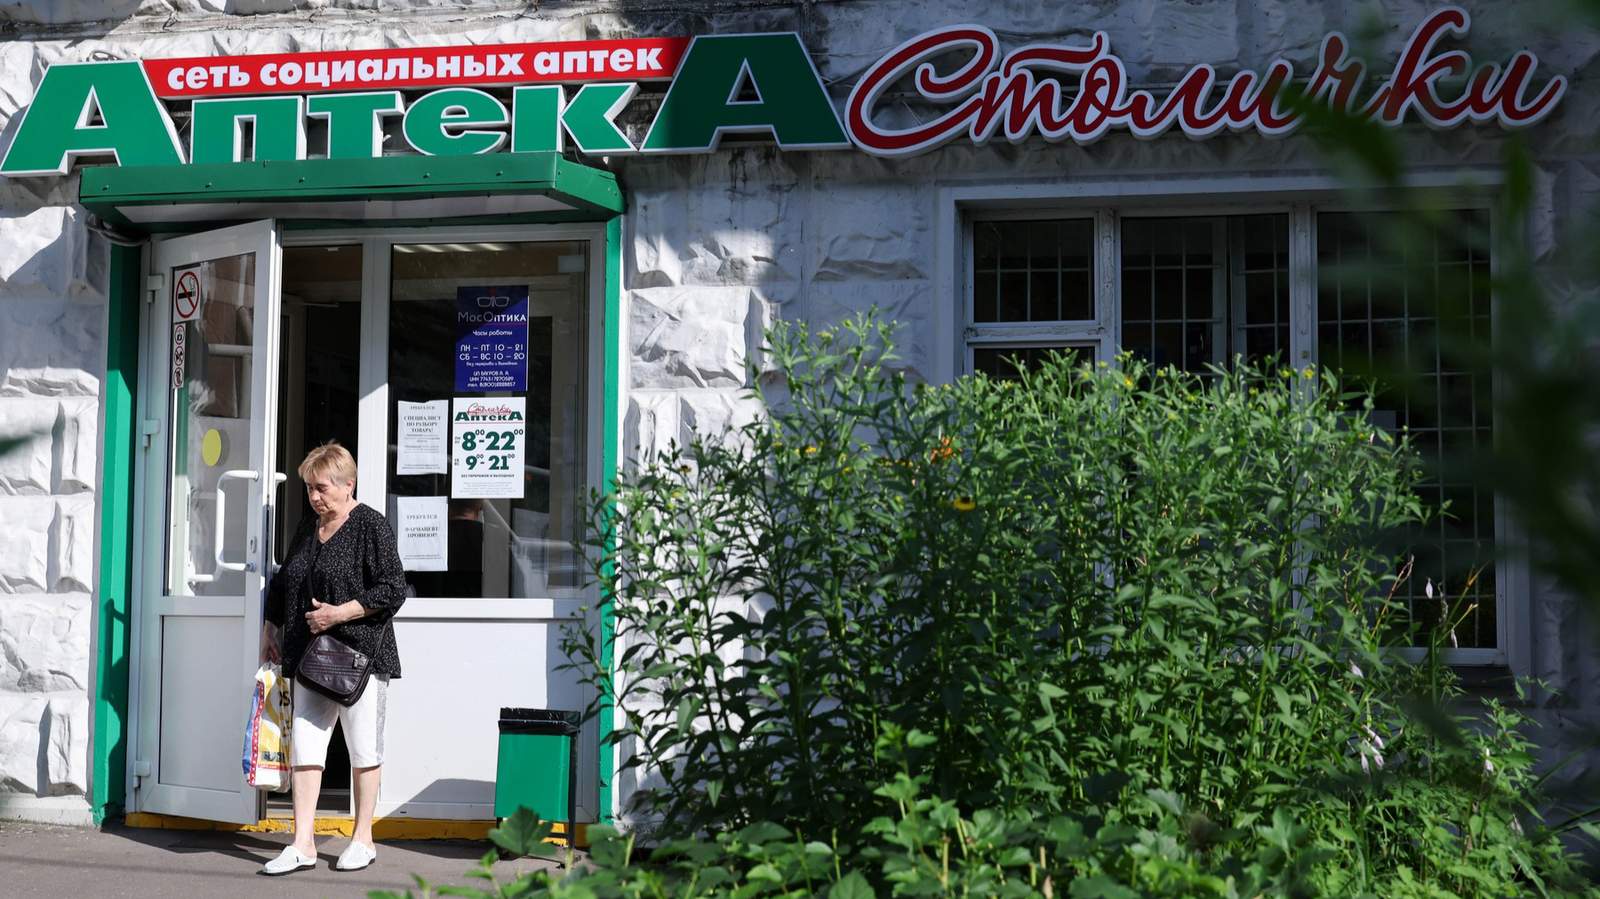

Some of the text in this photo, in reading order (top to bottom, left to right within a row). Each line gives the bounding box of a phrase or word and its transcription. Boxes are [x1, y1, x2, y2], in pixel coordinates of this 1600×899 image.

[167, 45, 664, 93] сеть социальных аптек
[844, 5, 1567, 157] Столички
[459, 353, 470, 361] СБ
[480, 353, 491, 361] ВС
[493, 353, 504, 361] 10
[514, 353, 525, 361] 20
[460, 344, 471, 352] ПН
[480, 344, 490, 352] ПТ
[495, 344, 505, 352] 10
[515, 344, 524, 352] 21
